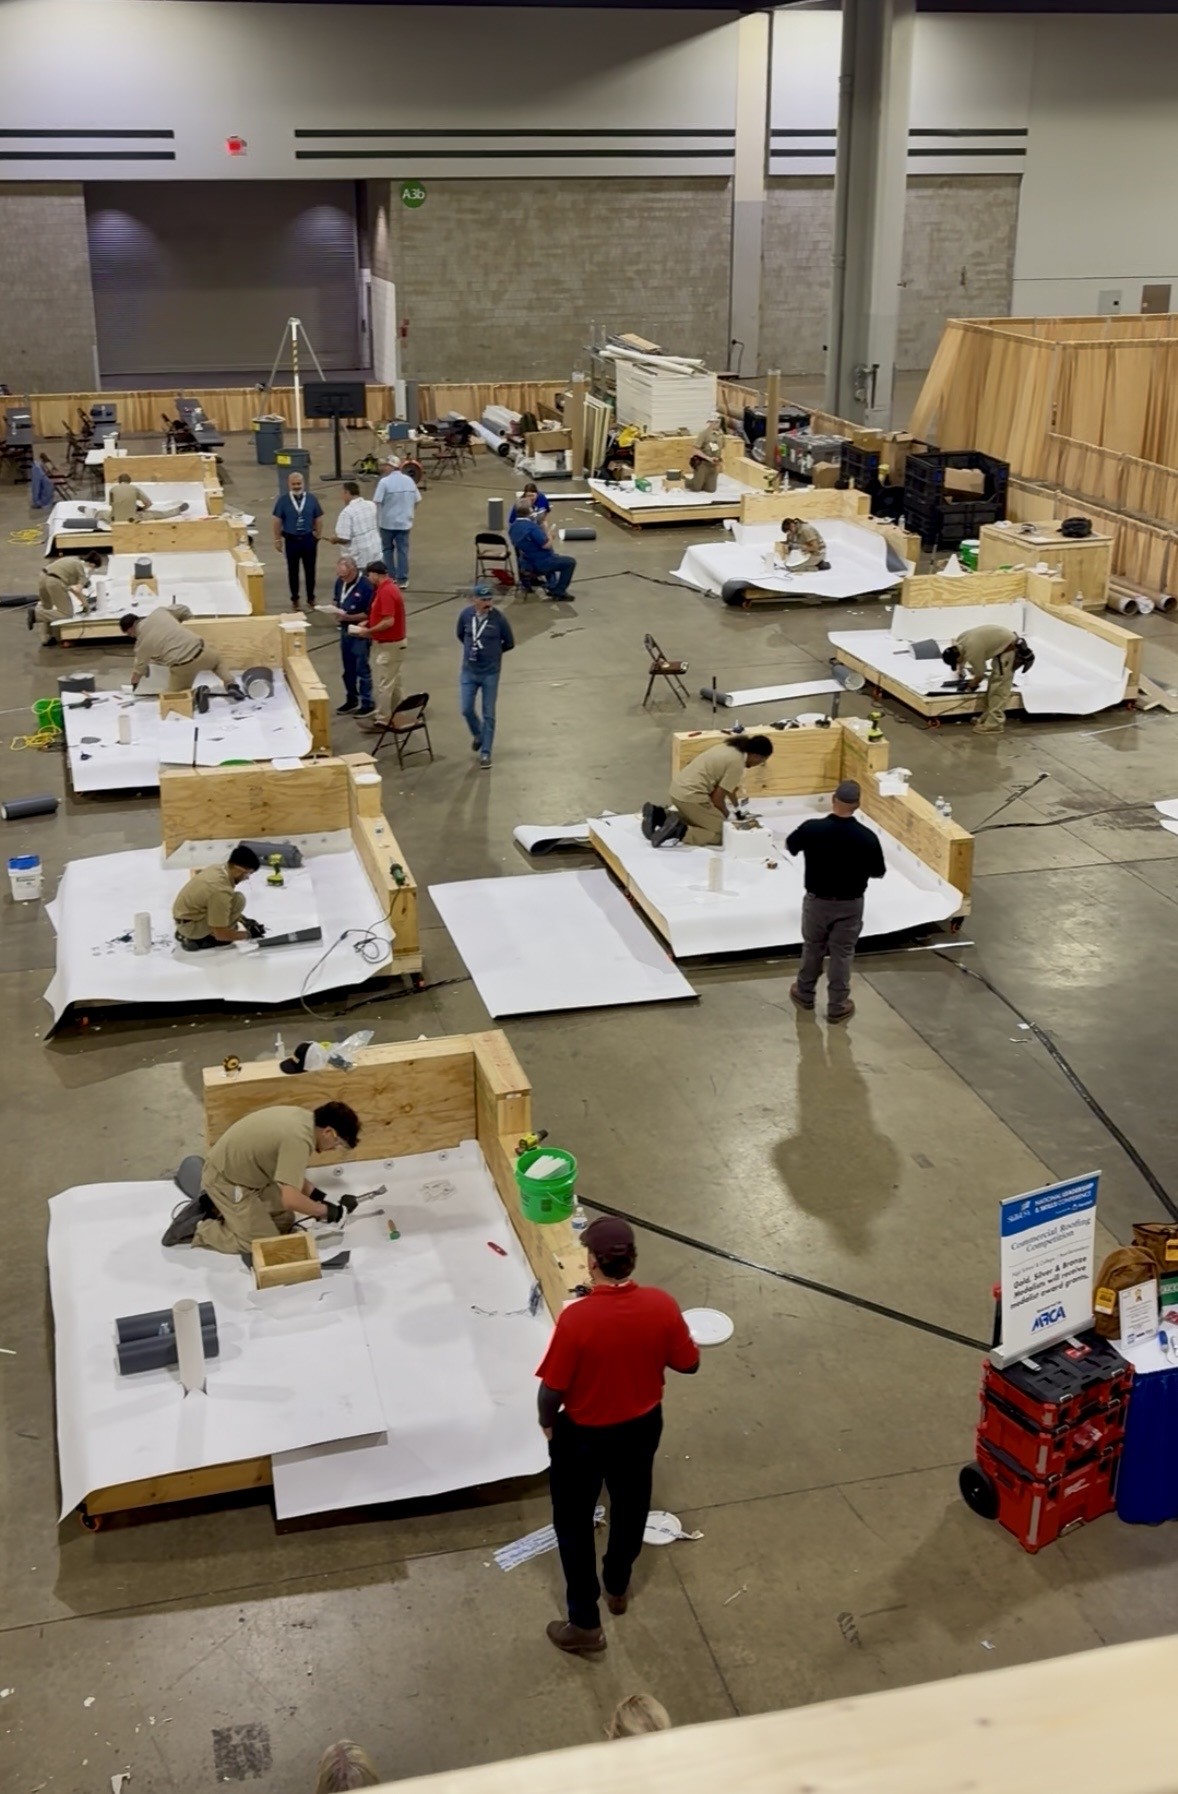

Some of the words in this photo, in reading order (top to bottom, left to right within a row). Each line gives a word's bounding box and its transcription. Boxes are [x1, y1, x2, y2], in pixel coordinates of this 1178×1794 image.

[403, 188, 425, 199] A3b
[1011, 1227, 1057, 1251] Commercial
[1060, 1217, 1091, 1233] Roofing
[1026, 1230, 1075, 1252] Competition
[1034, 1268, 1053, 1281] Silver
[1055, 1264, 1061, 1272] &
[1063, 1256, 1087, 1269] Bronze
[1047, 1273, 1060, 1284] will
